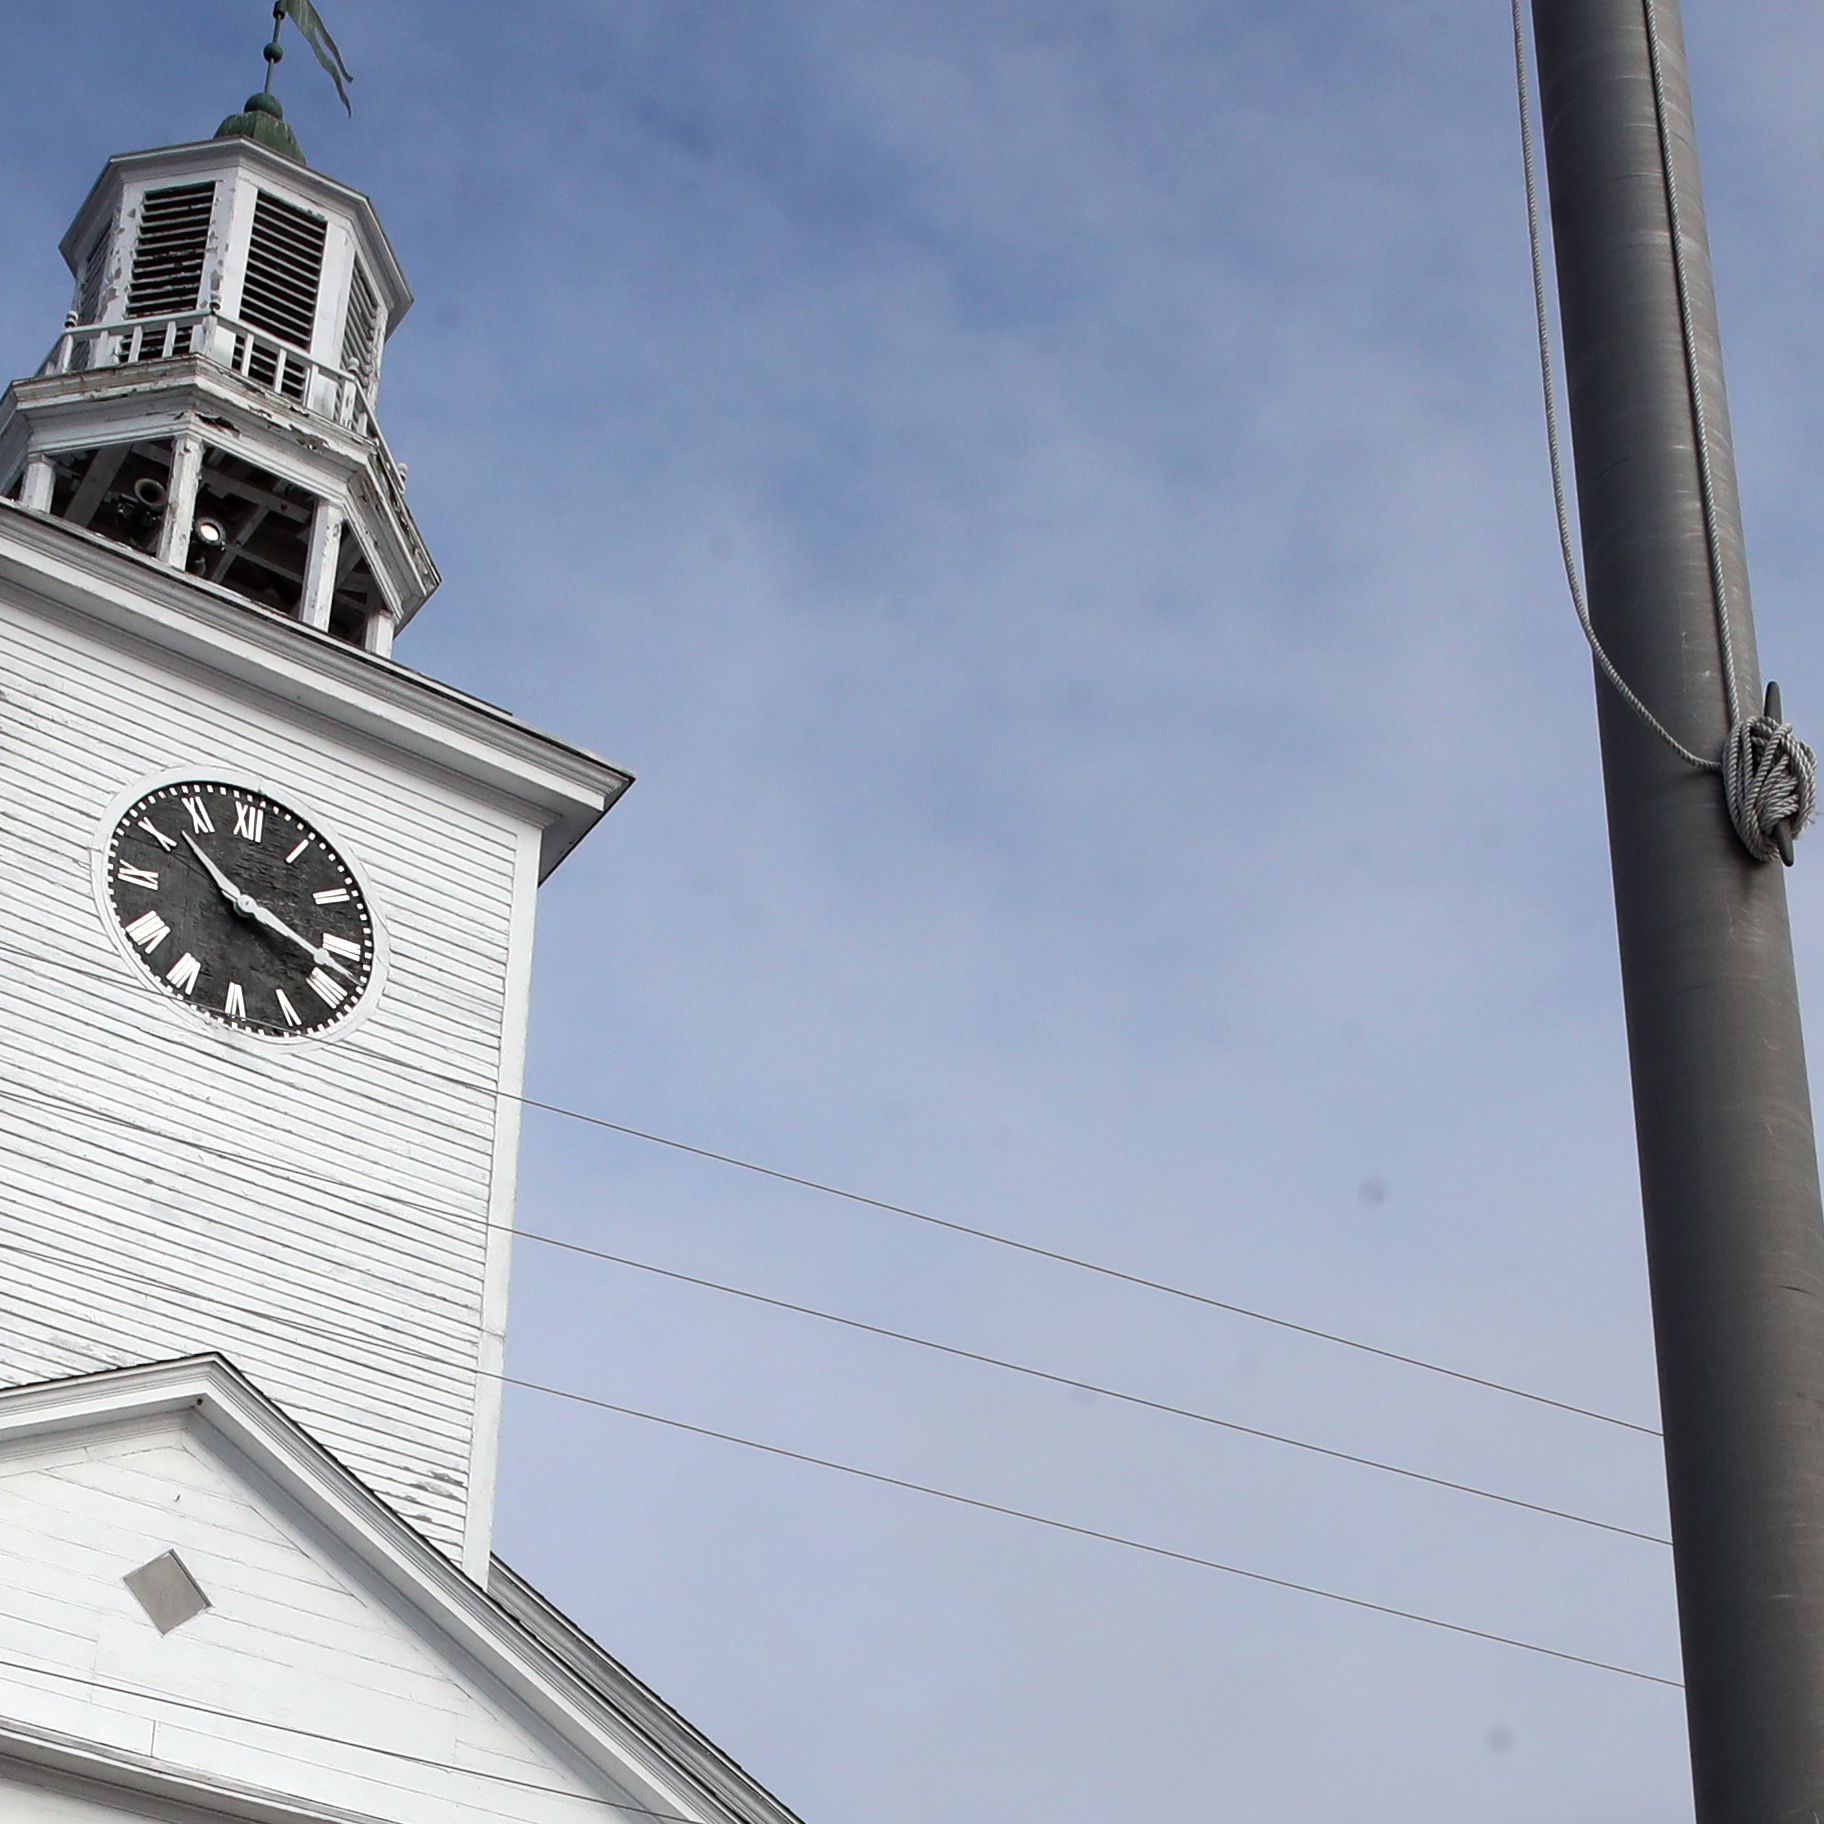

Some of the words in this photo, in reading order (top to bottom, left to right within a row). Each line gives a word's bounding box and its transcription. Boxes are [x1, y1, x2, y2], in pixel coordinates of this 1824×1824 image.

[138, 816, 177, 852] X
[181, 796, 216, 835] XI
[233, 801, 264, 843] XII
[285, 838, 309, 864] I
[117, 859, 159, 891] IX
[312, 888, 351, 905] II
[125, 910, 171, 955] VIII
[322, 932, 361, 962] III
[165, 952, 201, 996] VII
[224, 981, 247, 1022] VI
[275, 988, 302, 1027] V
